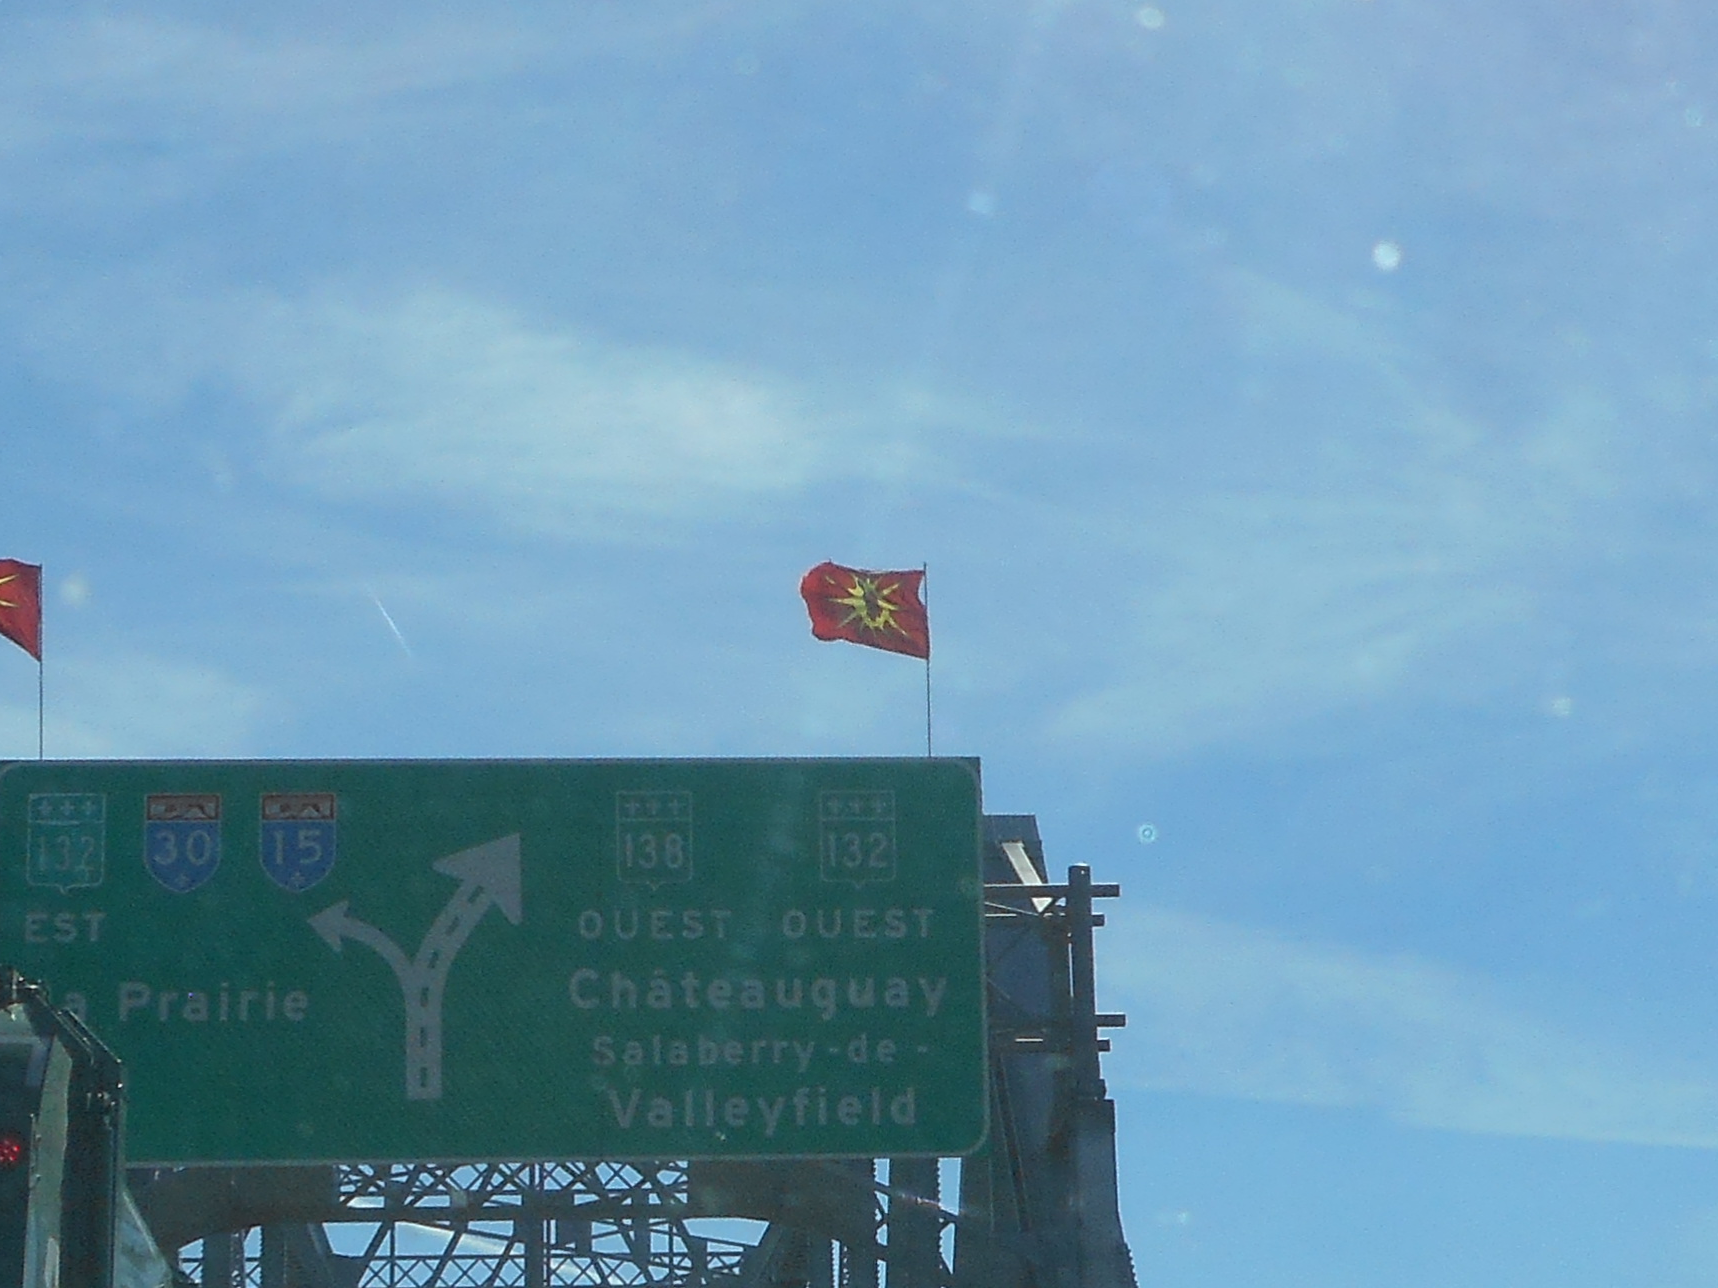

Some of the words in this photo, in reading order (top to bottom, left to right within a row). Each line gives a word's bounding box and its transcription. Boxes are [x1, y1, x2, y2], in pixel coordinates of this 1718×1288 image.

[36, 835, 95, 873] 132
[153, 829, 212, 866] 30
[273, 829, 322, 865] 15
[624, 833, 683, 869] 138
[827, 832, 888, 869] 132
[25, 912, 107, 944] EST
[579, 909, 733, 940] OUEST
[782, 909, 936, 940] OUEST
[119, 981, 310, 1022] Prairie
[568, 968, 948, 1020] Châteauguay
[608, 1086, 917, 1137] Valleyfield
